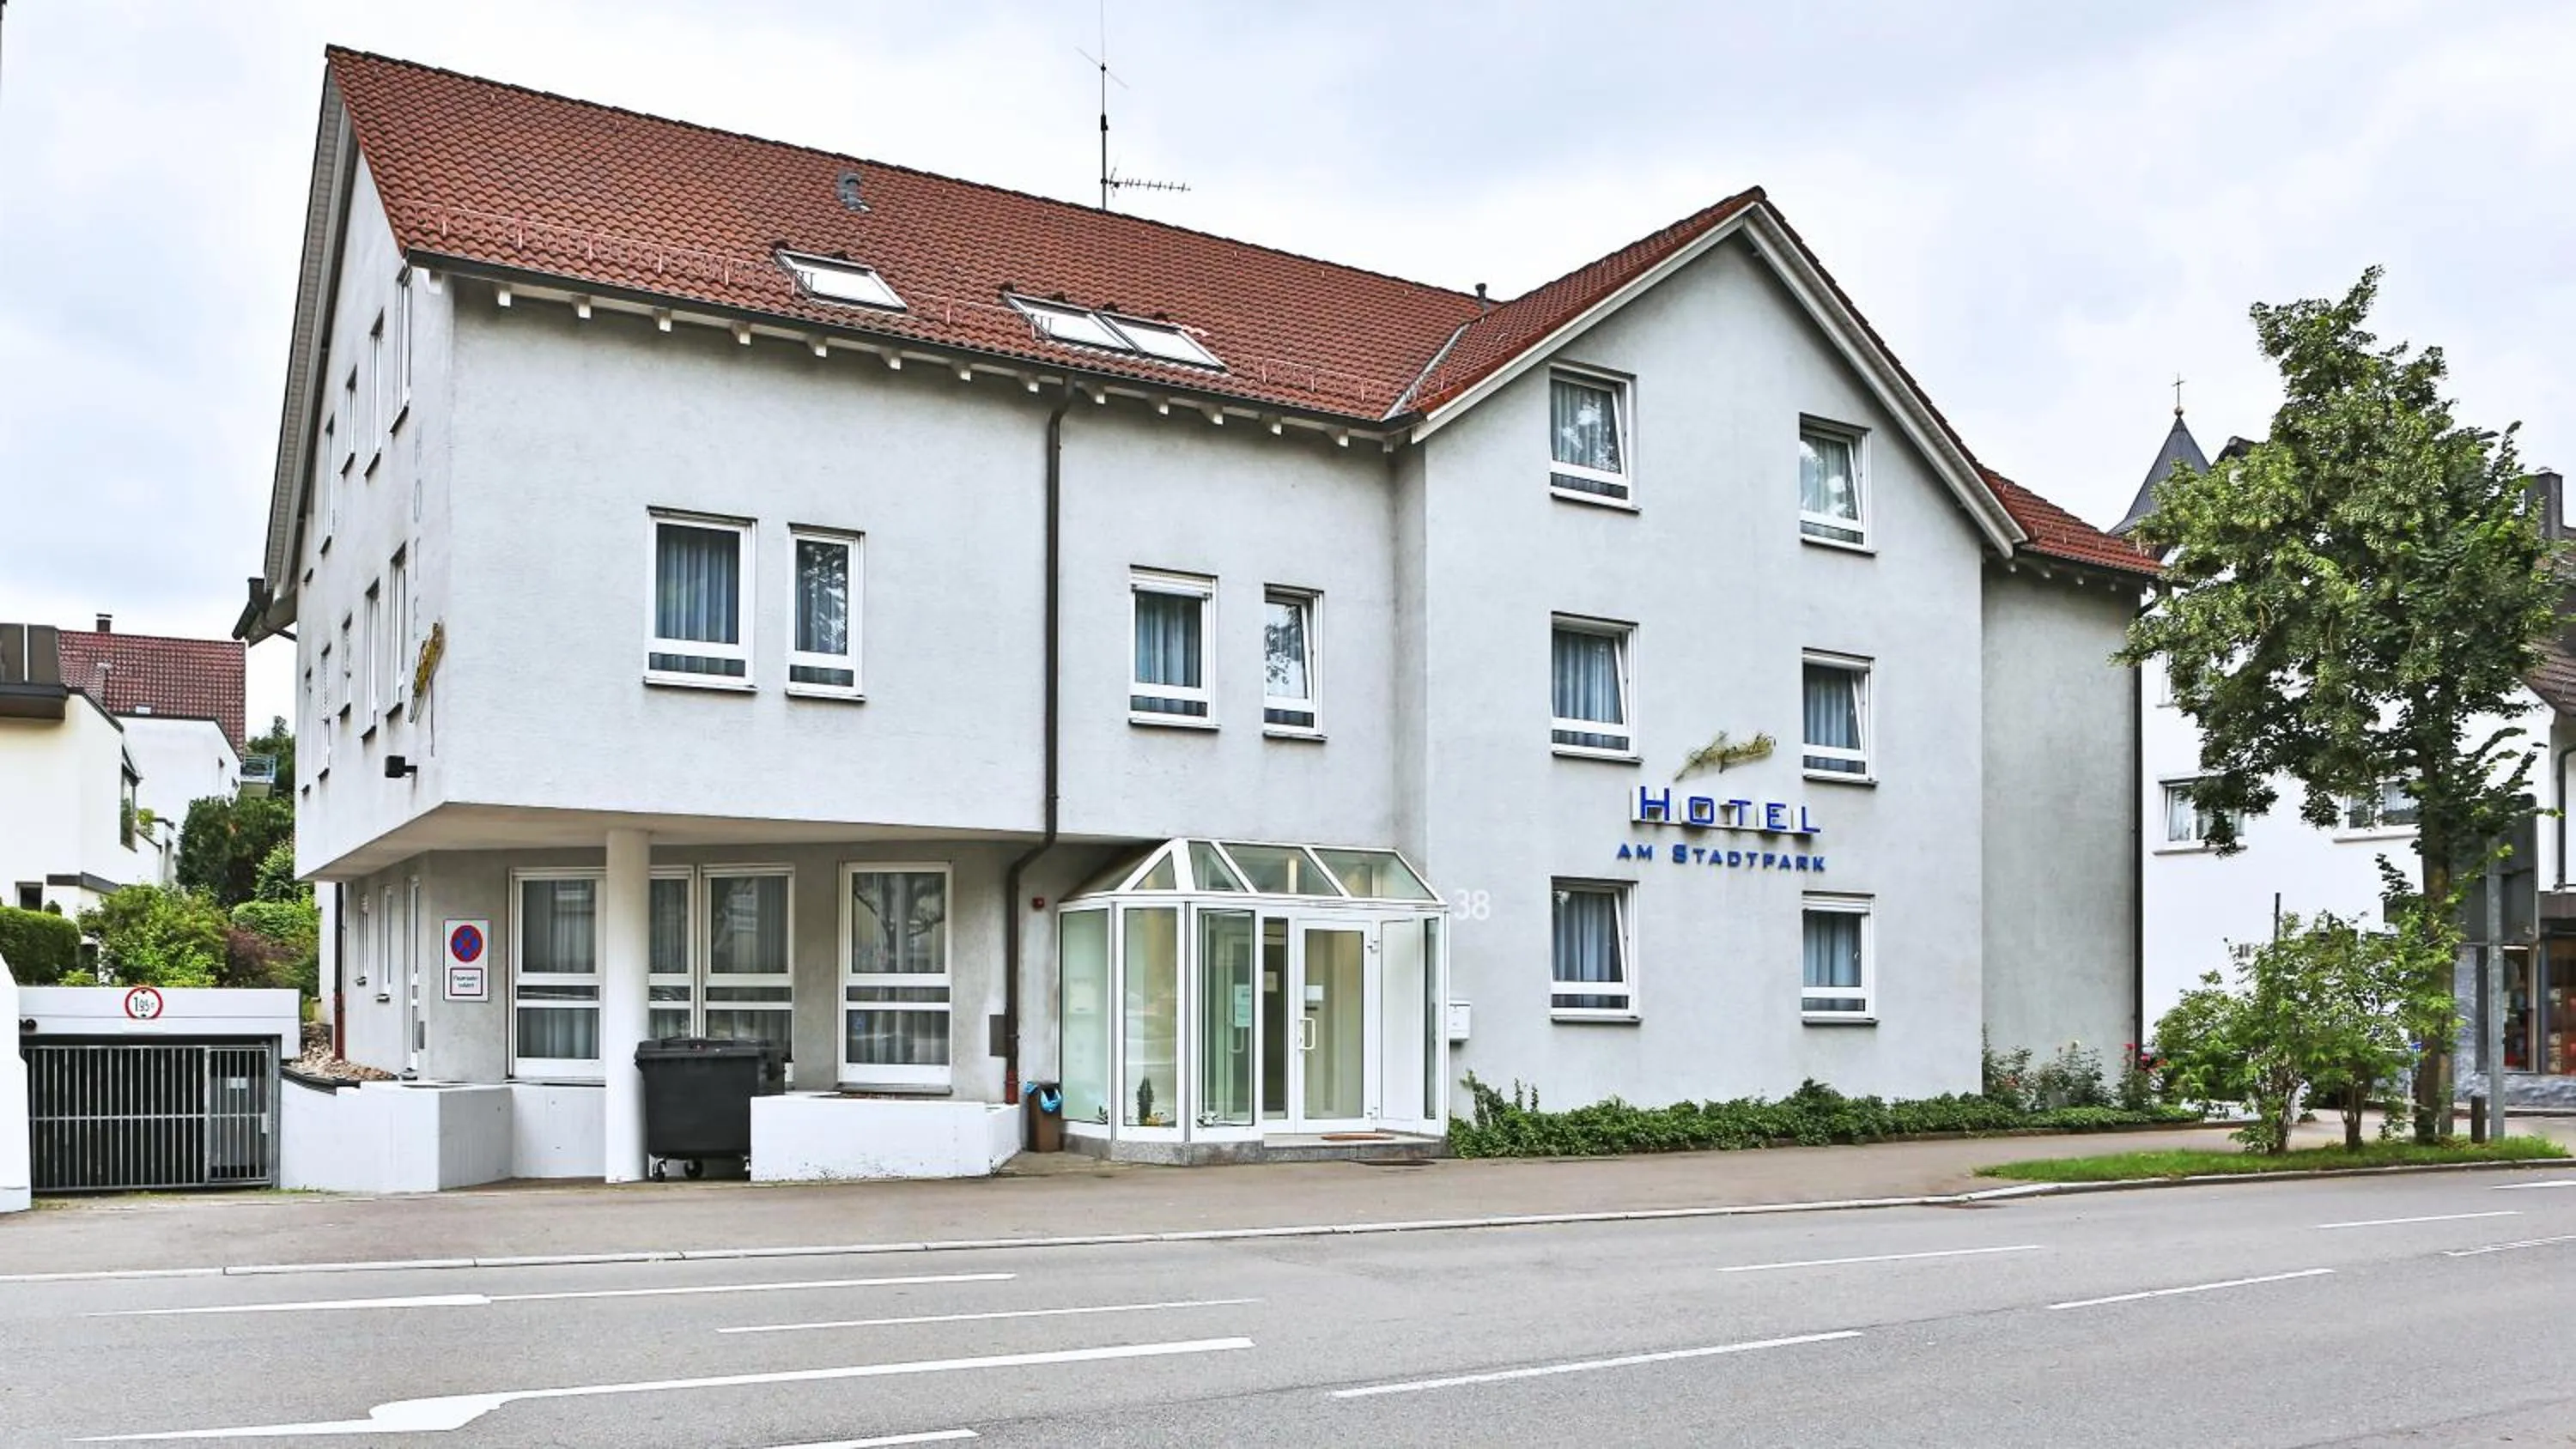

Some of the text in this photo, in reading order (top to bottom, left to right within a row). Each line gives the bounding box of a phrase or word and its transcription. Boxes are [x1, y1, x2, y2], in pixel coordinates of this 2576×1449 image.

[1631, 785, 1821, 833] HOTEL
[1617, 843, 1826, 872] AM STADTPARK
[1455, 889, 1490, 920] 38
